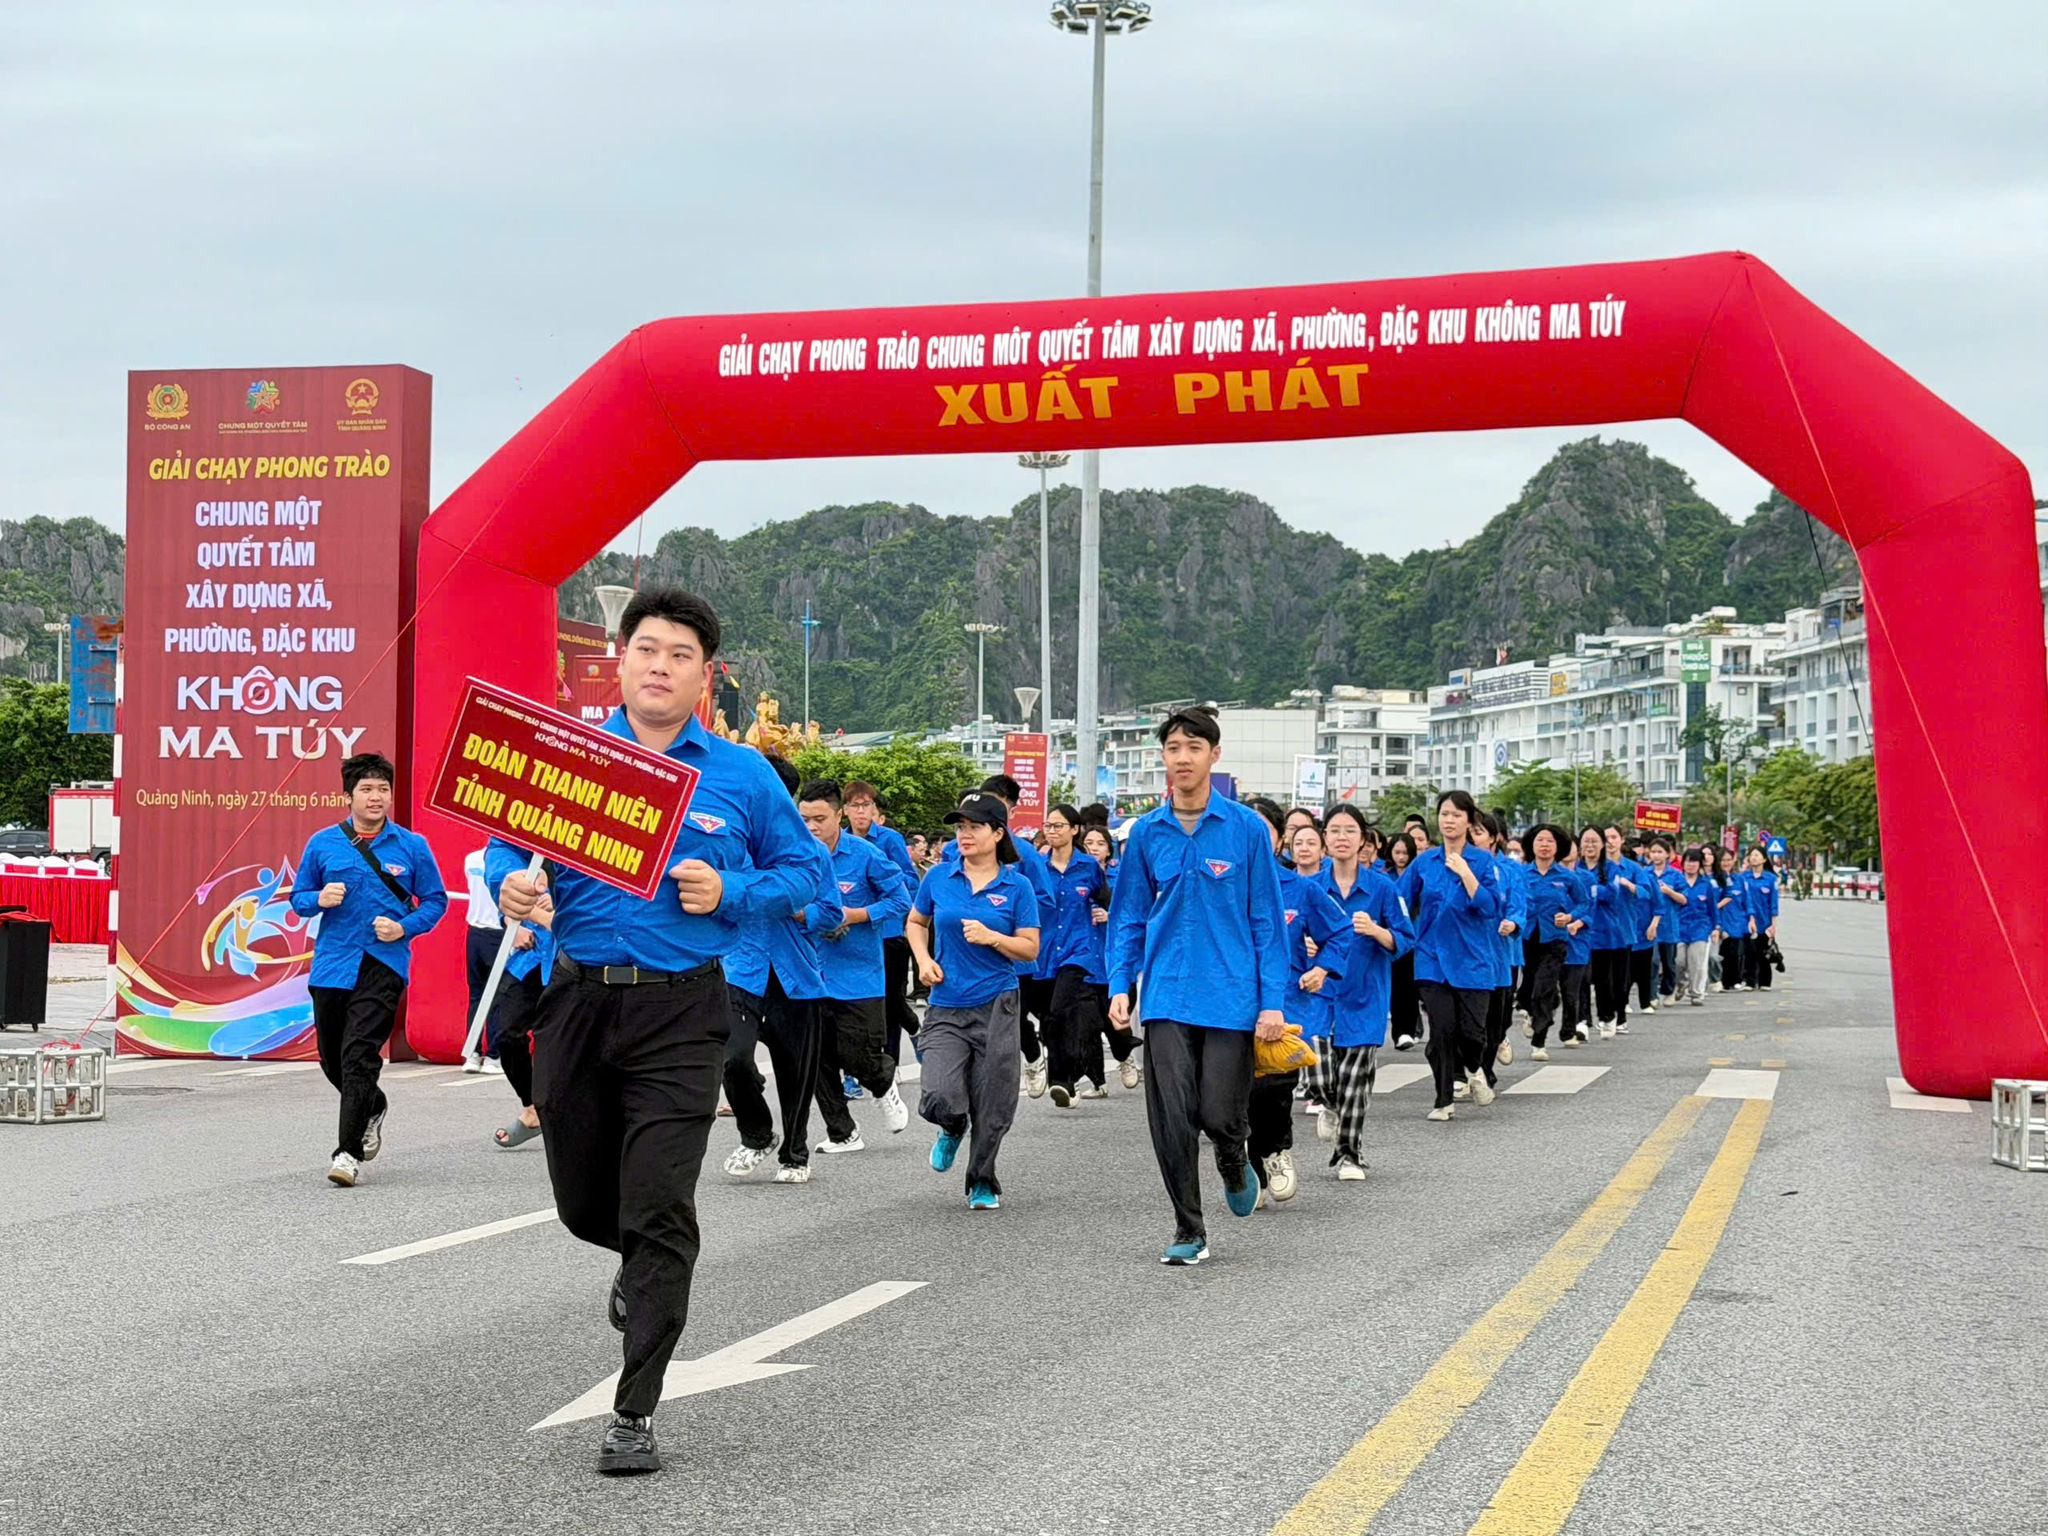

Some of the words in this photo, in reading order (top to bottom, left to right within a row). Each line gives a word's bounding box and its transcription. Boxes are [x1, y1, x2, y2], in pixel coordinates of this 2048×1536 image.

[719, 333, 753, 377] GIẢI
[758, 341, 803, 381] CHẠY
[809, 338, 867, 372] PHONG
[926, 334, 985, 369] CHUNG
[1038, 318, 1094, 367] QUYẾT
[1102, 320, 1140, 359] TÂM
[1148, 316, 1185, 356] XÂY
[1193, 317, 1243, 361] DỰNG
[1251, 312, 1284, 356] XÃ,
[1291, 307, 1375, 352] PHƯỜNG,
[1380, 305, 1419, 353] ĐẶC
[1427, 308, 1467, 344] KHU
[1474, 299, 1540, 342] KHÔNG
[1549, 303, 1581, 339] MA
[1589, 293, 1626, 338] TÚY
[934, 364, 1118, 427] XUẤT
[1173, 356, 1369, 415] PHÁT
[218, 422, 246, 430] CHUNG
[149, 449, 190, 480] GIẢI
[195, 456, 251, 485] CHẠY
[255, 455, 328, 478] PHONG
[334, 448, 391, 478] TRÀO
[195, 501, 268, 527] CHUNG
[274, 495, 322, 530] MỘT
[197, 534, 264, 570] QUYẾT
[268, 537, 316, 567] TÂM
[186, 579, 228, 609] XÂY
[233, 581, 291, 613] DỰNG
[297, 578, 332, 610] XÃ,
[164, 622, 257, 655] PHƯỜNG,
[262, 623, 306, 658] ĐẶC
[312, 628, 356, 652] KHU
[177, 665, 343, 715] KHÔNG
[581, 706, 604, 720] MA
[158, 726, 243, 759] MA
[255, 718, 367, 760] TÚY
[534, 731, 569, 752] KHÔNG
[569, 746, 586, 760] MA
[589, 753, 612, 768] TÚY
[136, 788, 178, 810] Quảng
[181, 789, 214, 809] Ninh,
[217, 792, 249, 810] ngày
[251, 791, 267, 806] 27
[269, 790, 307, 811] tháng
[310, 791, 317, 806] 6
[462, 732, 528, 779] ĐOÀN
[532, 759, 604, 810] THANH
[604, 791, 662, 835] NIÊN
[453, 773, 506, 819] TỈNH
[507, 799, 585, 851] QUẢNG
[584, 831, 644, 875] NINH
